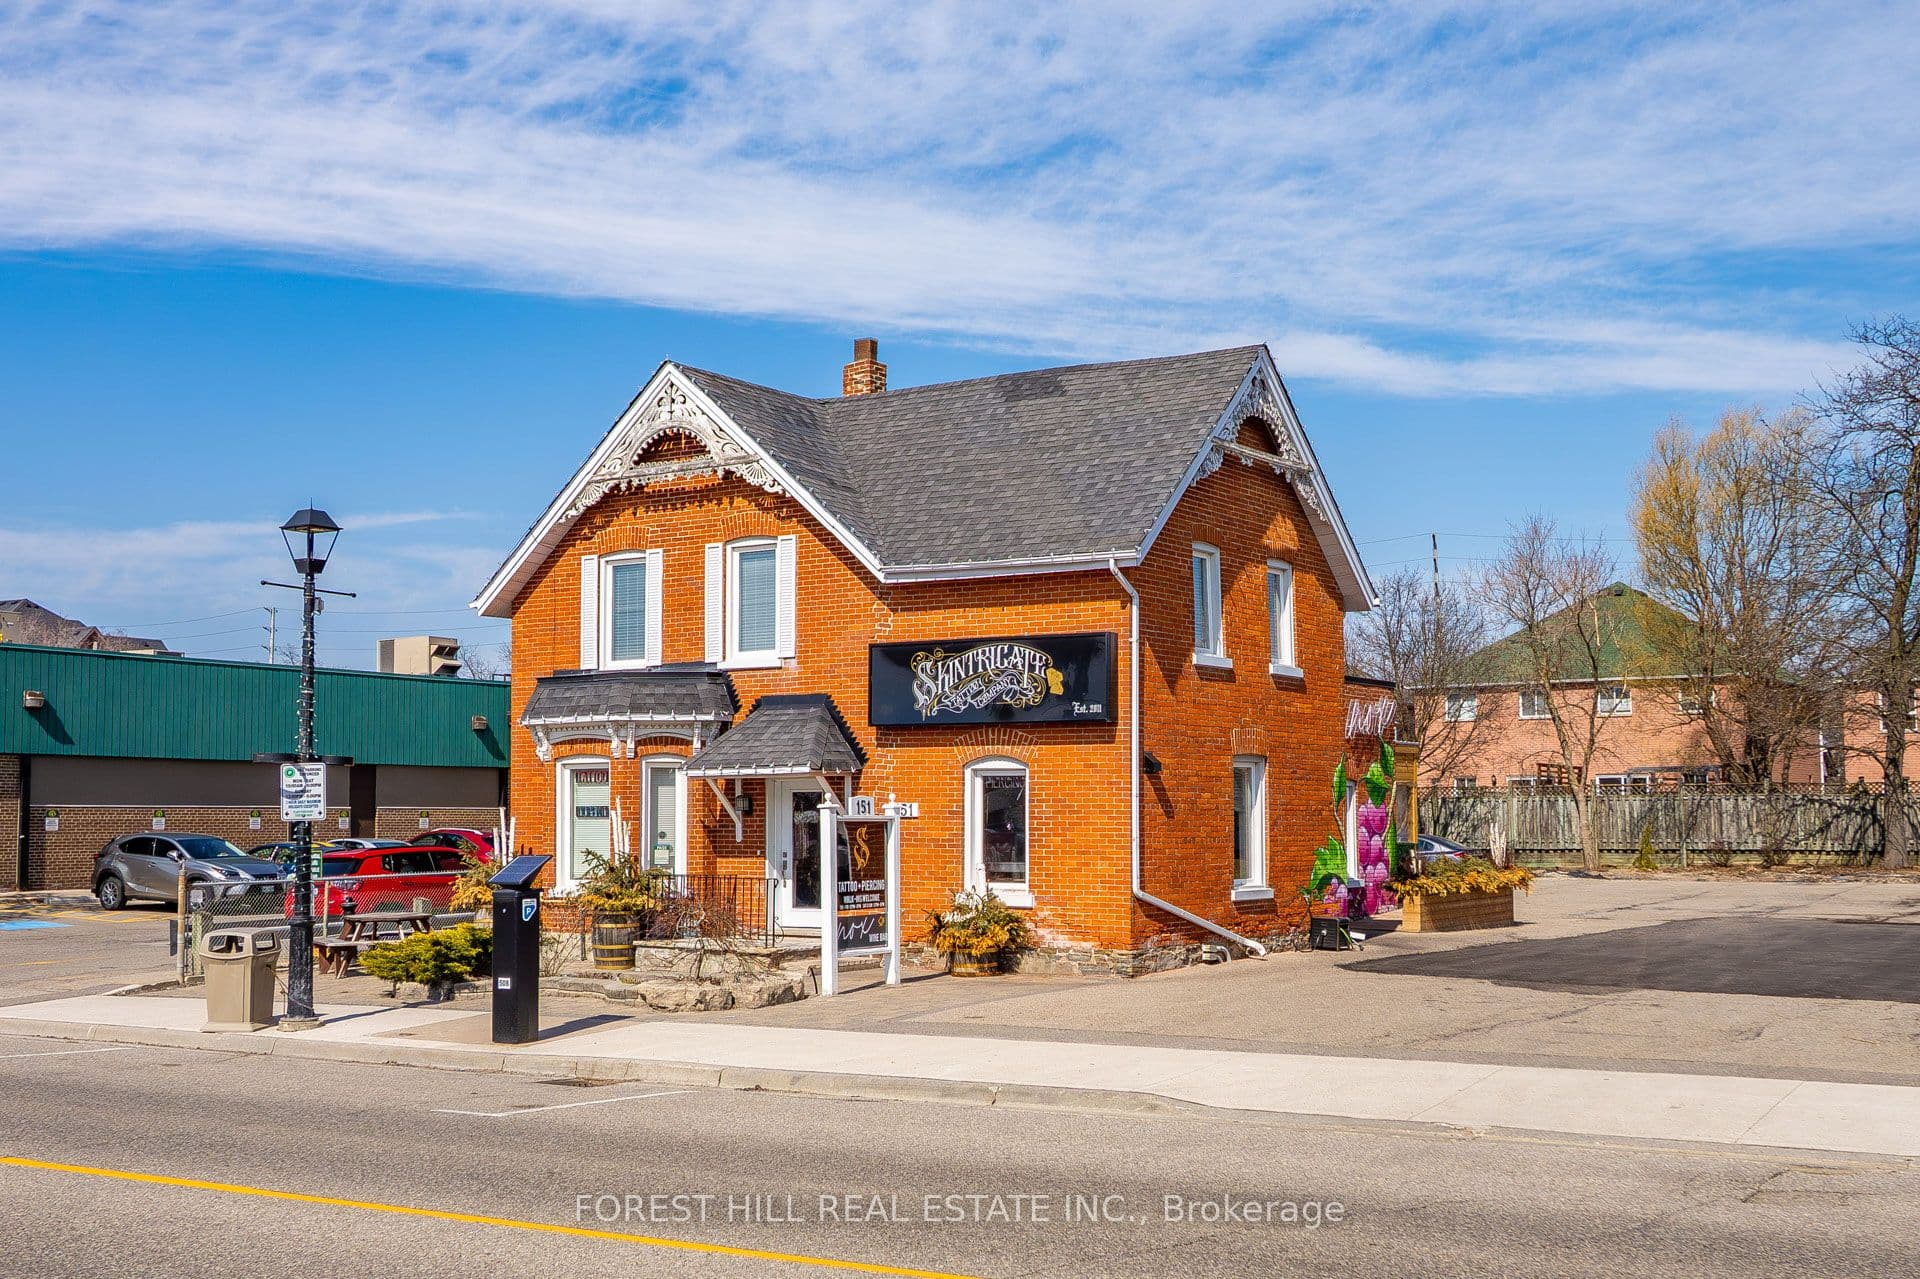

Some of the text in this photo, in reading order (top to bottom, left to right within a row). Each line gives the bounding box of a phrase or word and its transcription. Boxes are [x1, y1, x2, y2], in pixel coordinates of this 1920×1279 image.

[912, 644, 1047, 708] SKINTRICATE
[977, 676, 1012, 706] COMPANY
[1071, 701, 1088, 717] Est.
[856, 799, 871, 815] 151
[900, 803, 913, 816] 51
[838, 879, 885, 893] TATTOO PIERCING
[526, 907, 532, 915] P
